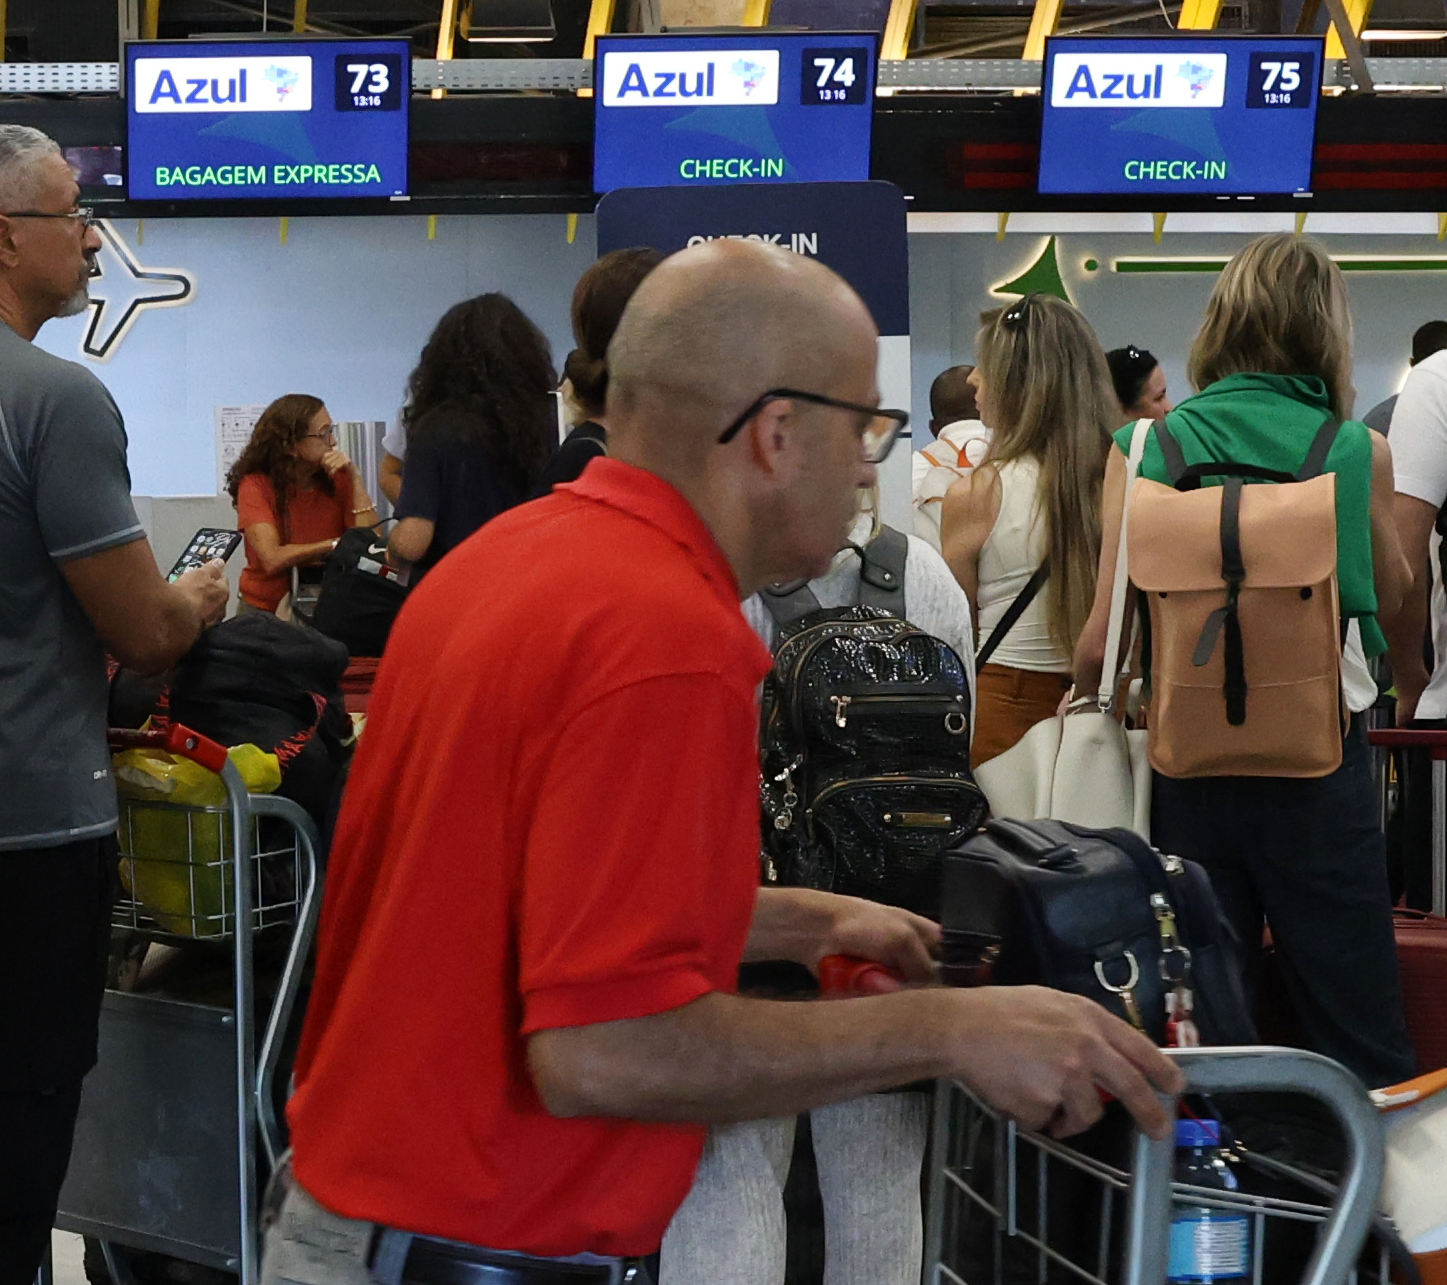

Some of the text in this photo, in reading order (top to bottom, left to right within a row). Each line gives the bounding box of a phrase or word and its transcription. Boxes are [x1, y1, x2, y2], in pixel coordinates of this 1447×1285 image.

[148, 68, 247, 104] Azul
[347, 64, 389, 94] 73
[616, 62, 715, 98] Azul
[813, 57, 855, 87] 74
[1065, 64, 1163, 99] Azul
[1260, 62, 1301, 91] 75
[353, 96, 381, 107] 13:16
[1264, 93, 1290, 104] 13:16
[155, 165, 381, 185] BAGAGEM EXPRESSA
[680, 159, 784, 178] CHECK-IN
[1124, 161, 1226, 180] CHECK-IN
